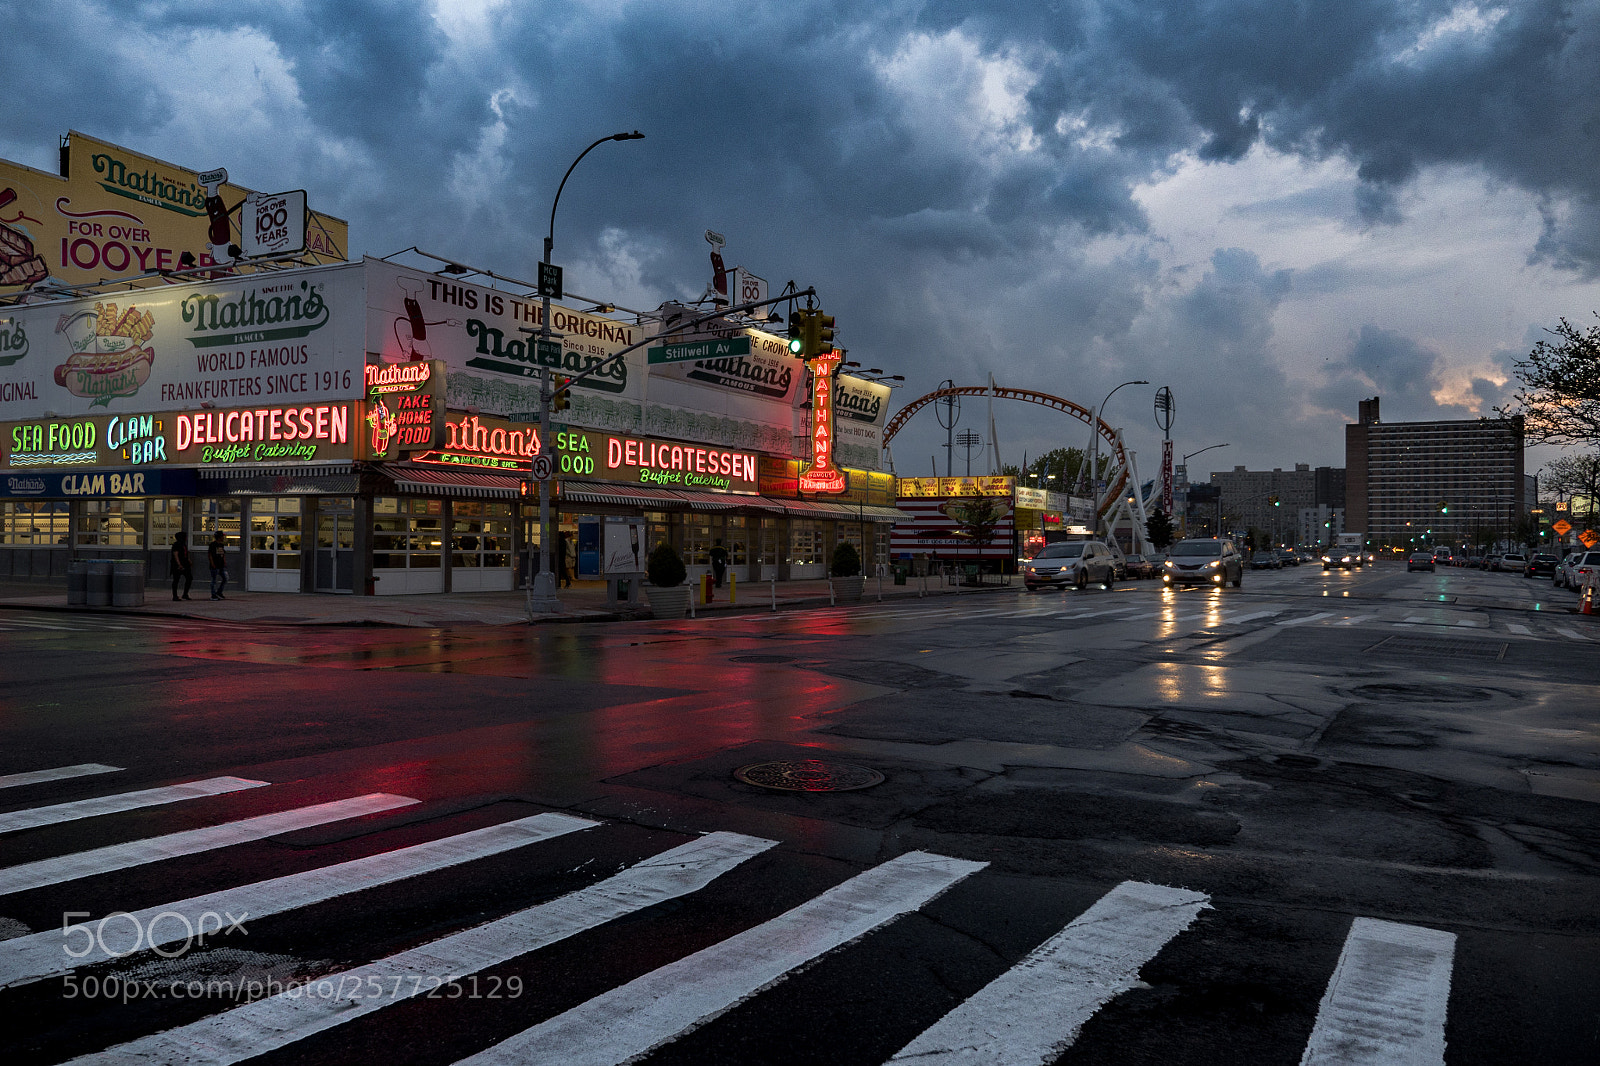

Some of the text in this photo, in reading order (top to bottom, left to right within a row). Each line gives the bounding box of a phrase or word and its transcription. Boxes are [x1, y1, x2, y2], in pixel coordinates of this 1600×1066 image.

[92, 154, 206, 210] Nathan's
[256, 199, 286, 215] FOR OVER
[69, 221, 151, 242] FOR OVER
[256, 208, 287, 234] 100
[255, 227, 288, 245] YEARS
[543, 275, 558, 285] Park
[742, 286, 760, 300] 100
[181, 280, 326, 331] Nathan's
[427, 279, 478, 310] THIS
[485, 294, 504, 315] IS
[554, 312, 634, 346] ORIGINAL
[466, 318, 628, 381] Natan's
[550, 345, 561, 354] Park
[564, 339, 605, 356] Since 1916
[665, 344, 731, 359] Stillwell Av
[762, 340, 790, 356] CROWD
[197, 345, 309, 372] WORLD FAMOUS
[77, 369, 137, 395] Nathan's
[365, 362, 431, 386] Nathan's
[0, 381, 38, 402] IGINAL
[161, 370, 351, 401] FRANKFURTERS SINCE 1916
[720, 378, 756, 392] FAMOUS
[398, 394, 431, 410] TAKE
[176, 405, 348, 451] DELICATESSEN
[398, 410, 433, 426] HOME
[12, 421, 97, 452] SEA FOOD
[107, 414, 154, 450] CLAM
[397, 426, 431, 445] FOOD
[445, 416, 542, 457] athan's
[557, 432, 590, 453] SEA
[853, 427, 864, 437] HOT
[865, 429, 876, 439] DOG
[132, 435, 168, 465] BAR
[201, 441, 317, 463] Buffet Catering
[441, 454, 499, 467] FAMOUS
[607, 437, 755, 482] DELICATESSEN
[561, 454, 594, 475] OOD
[61, 472, 146, 496] CLAM BAR
[639, 468, 731, 490] Buffet Catering
